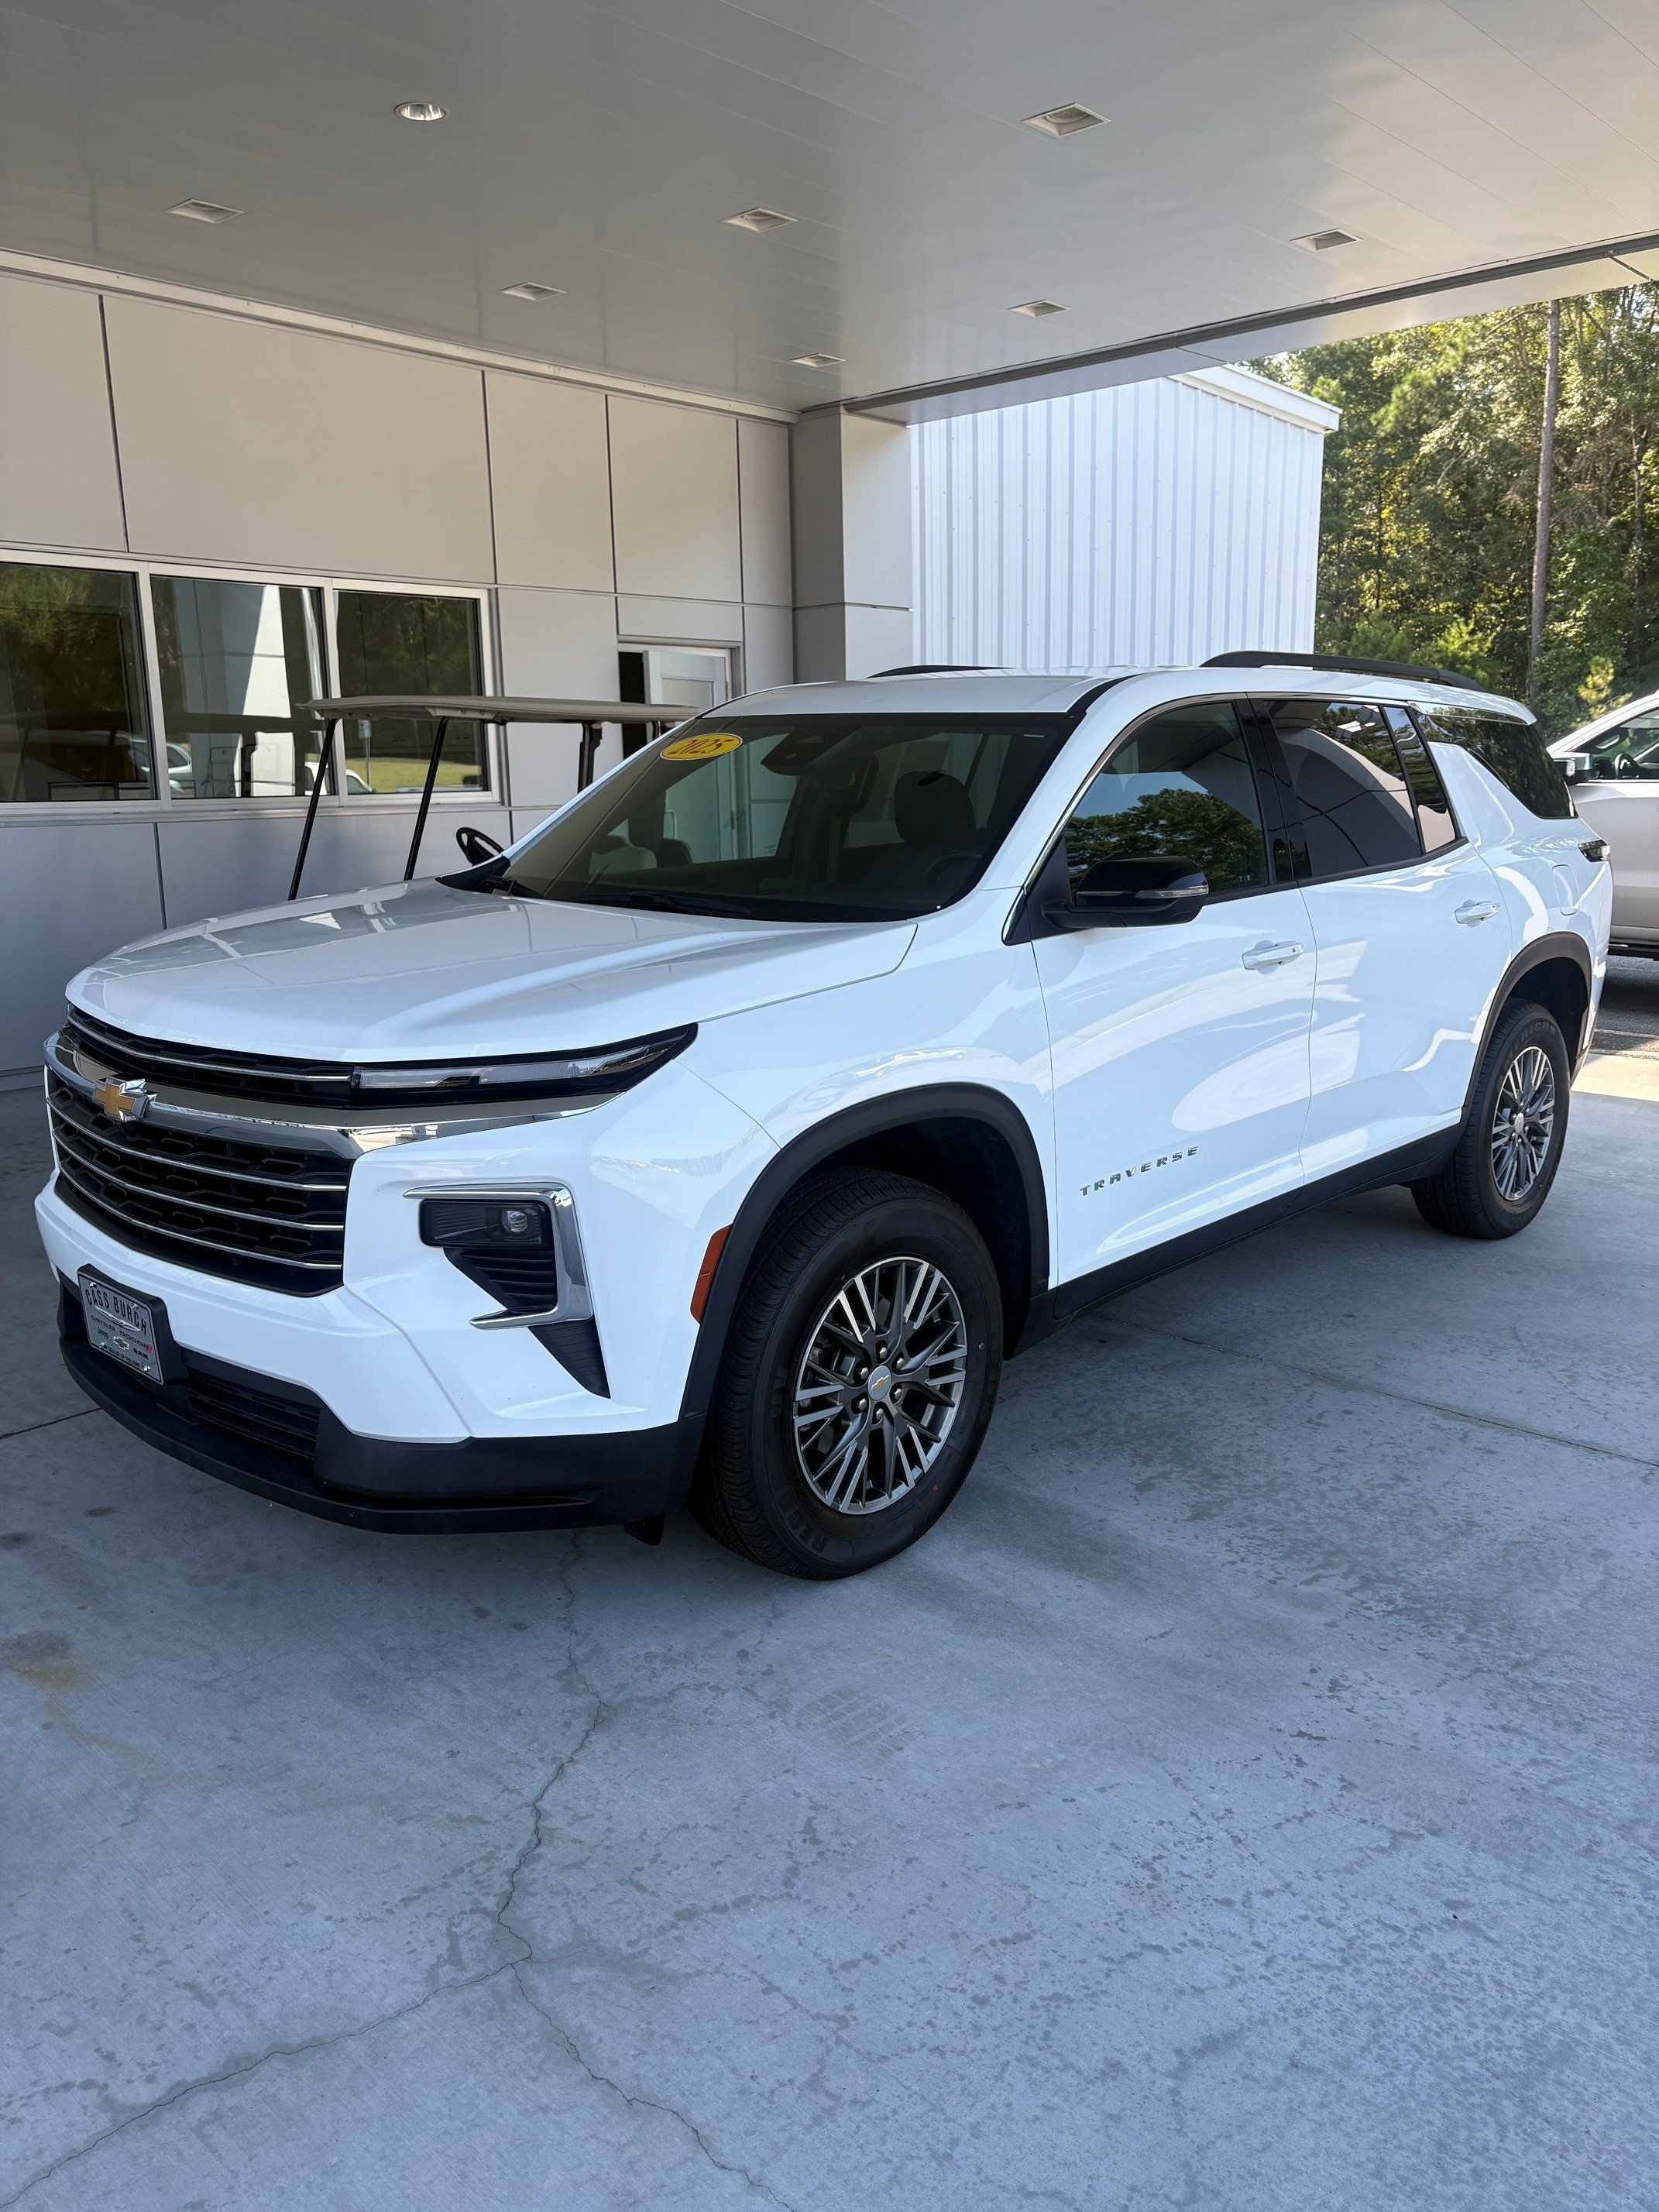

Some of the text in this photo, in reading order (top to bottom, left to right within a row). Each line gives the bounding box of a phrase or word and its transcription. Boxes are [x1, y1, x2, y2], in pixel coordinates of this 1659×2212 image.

[667, 738, 735, 755] 2025
[1080, 1146, 1199, 1196] TRAVERSE
[85, 1289, 146, 1335] CASS BURCH
[120, 1331, 147, 1348] DODGE
[133, 1348, 149, 1360] RAM
